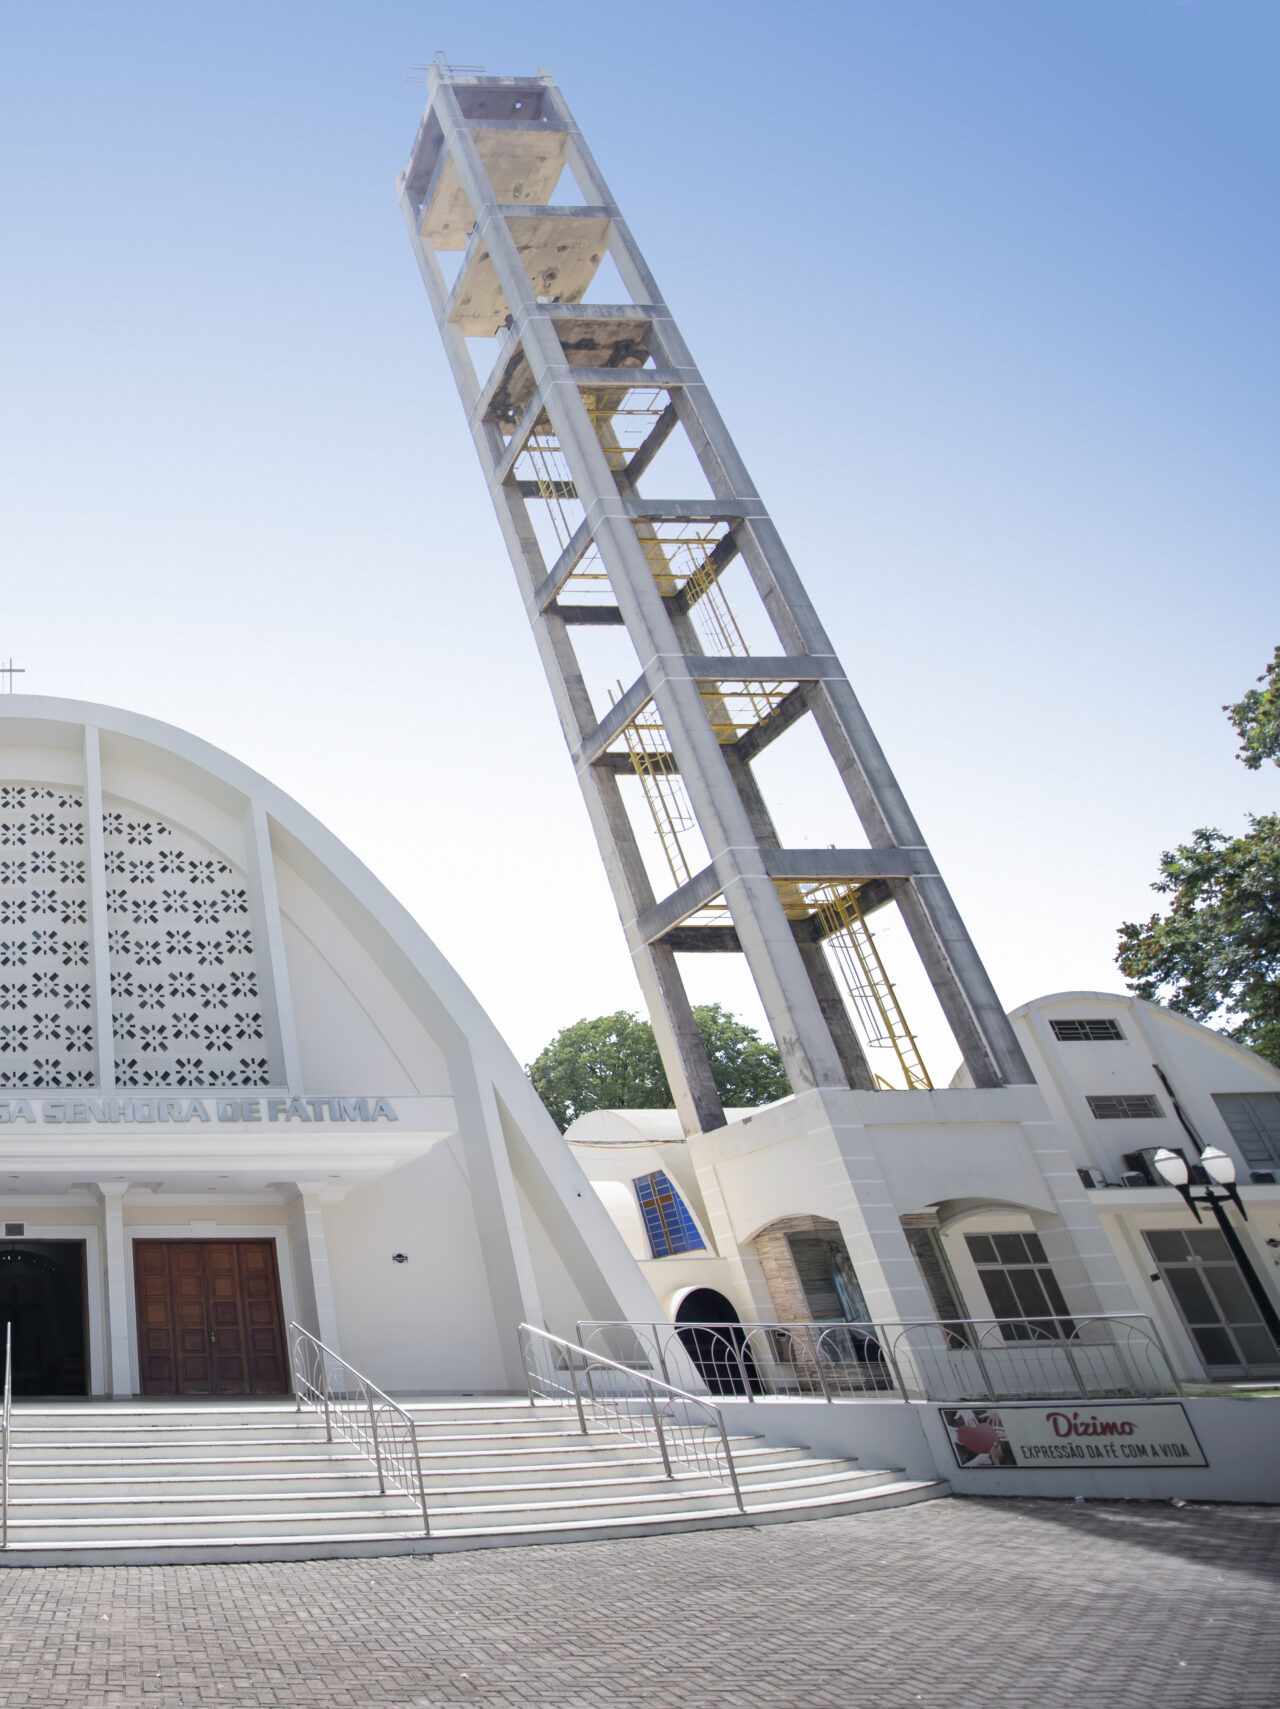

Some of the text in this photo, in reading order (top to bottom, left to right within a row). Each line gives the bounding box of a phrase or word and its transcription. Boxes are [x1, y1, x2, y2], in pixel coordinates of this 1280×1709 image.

[43, 1099, 211, 1123] SENHORA
[217, 1099, 262, 1123] DE
[1046, 1411, 1138, 1438] Dízimo
[1021, 1441, 1191, 1460] EXPRESSÃO DA FÉ COM A VIDA
